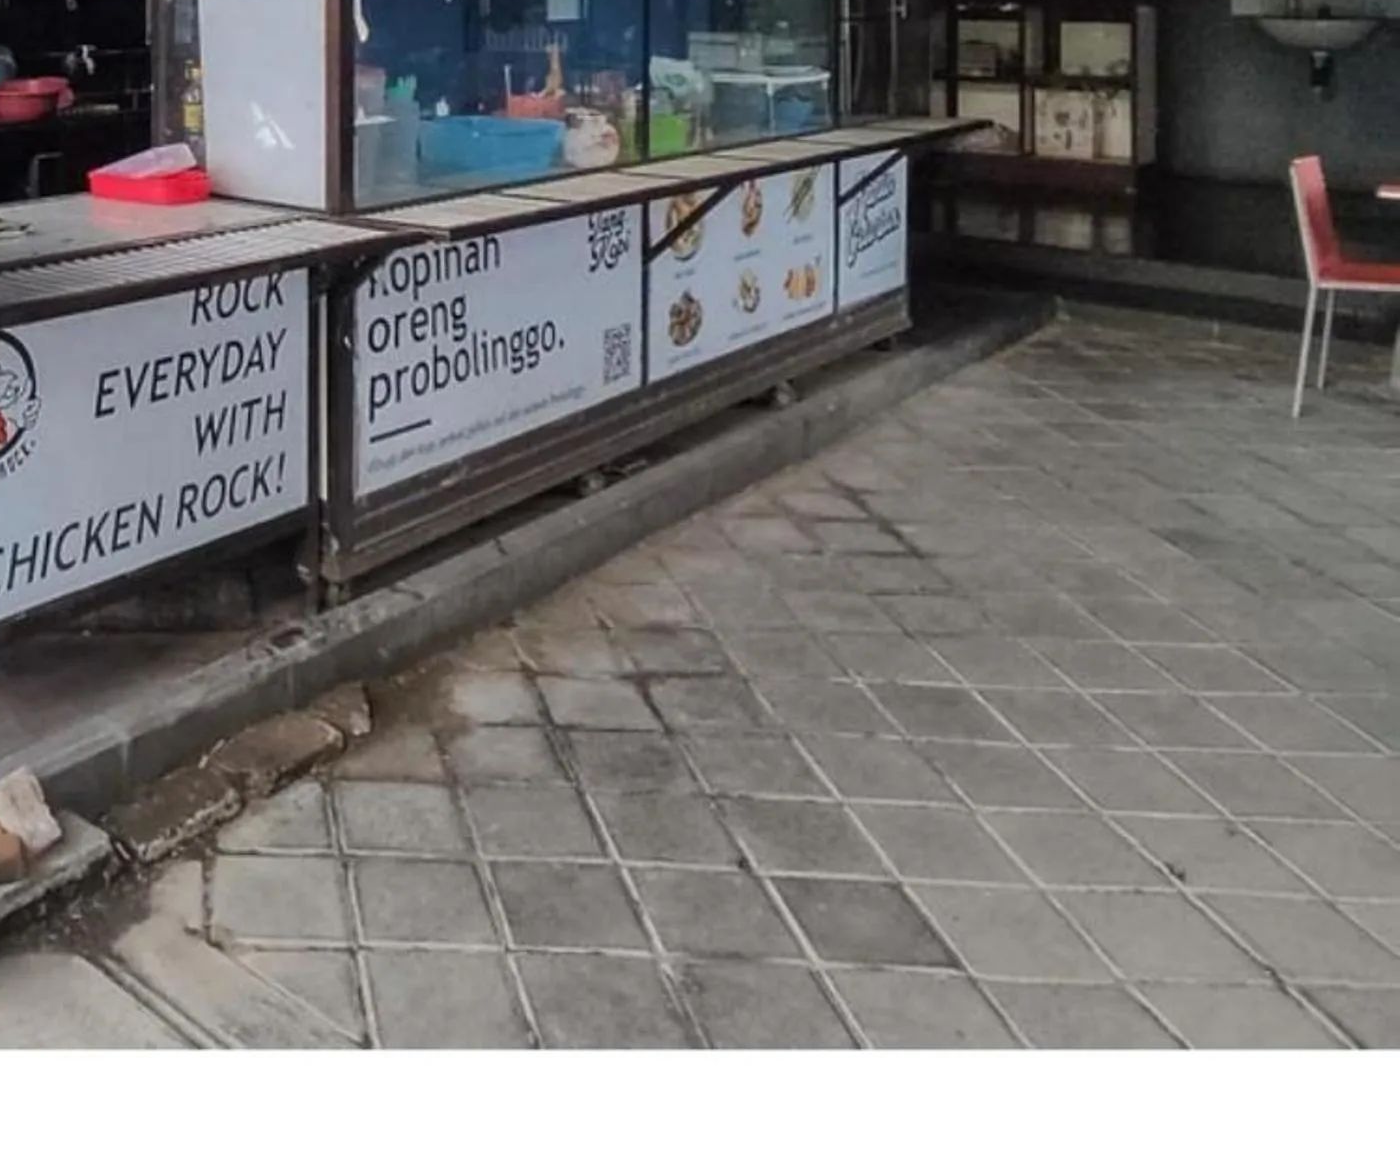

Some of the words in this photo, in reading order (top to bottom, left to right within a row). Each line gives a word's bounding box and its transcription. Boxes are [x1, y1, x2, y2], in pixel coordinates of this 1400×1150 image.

[191, 271, 285, 326] ROCK
[367, 295, 467, 353] oreng
[95, 328, 287, 419] EVERYDAY
[369, 320, 565, 423] probolinggo.
[194, 390, 287, 456] WITH
[176, 452, 287, 529] ROCK!
